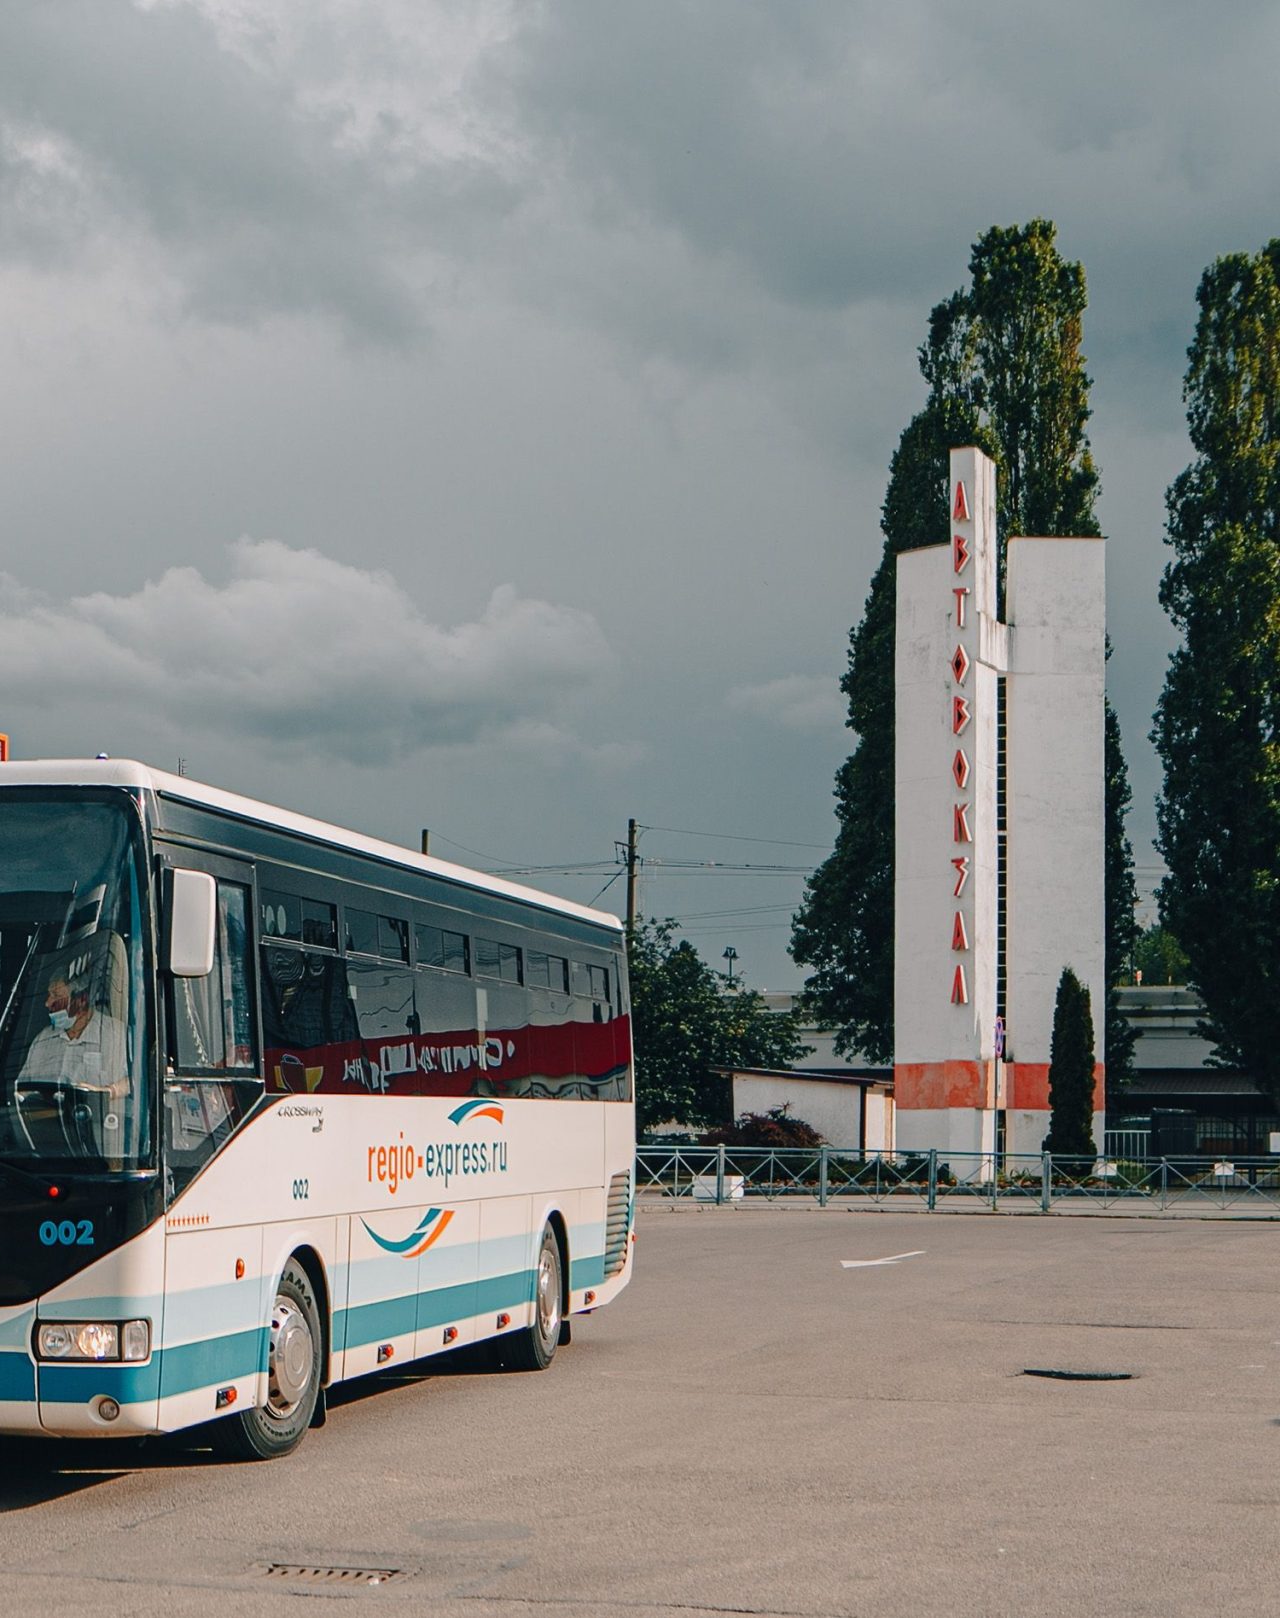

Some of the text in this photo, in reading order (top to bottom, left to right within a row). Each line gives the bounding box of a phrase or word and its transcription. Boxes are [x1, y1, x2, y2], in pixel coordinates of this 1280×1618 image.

[951, 481, 972, 1005] АВТОВОКЗАЛ
[293, 1179, 309, 1200] 002
[39, 1220, 95, 1246] 002
